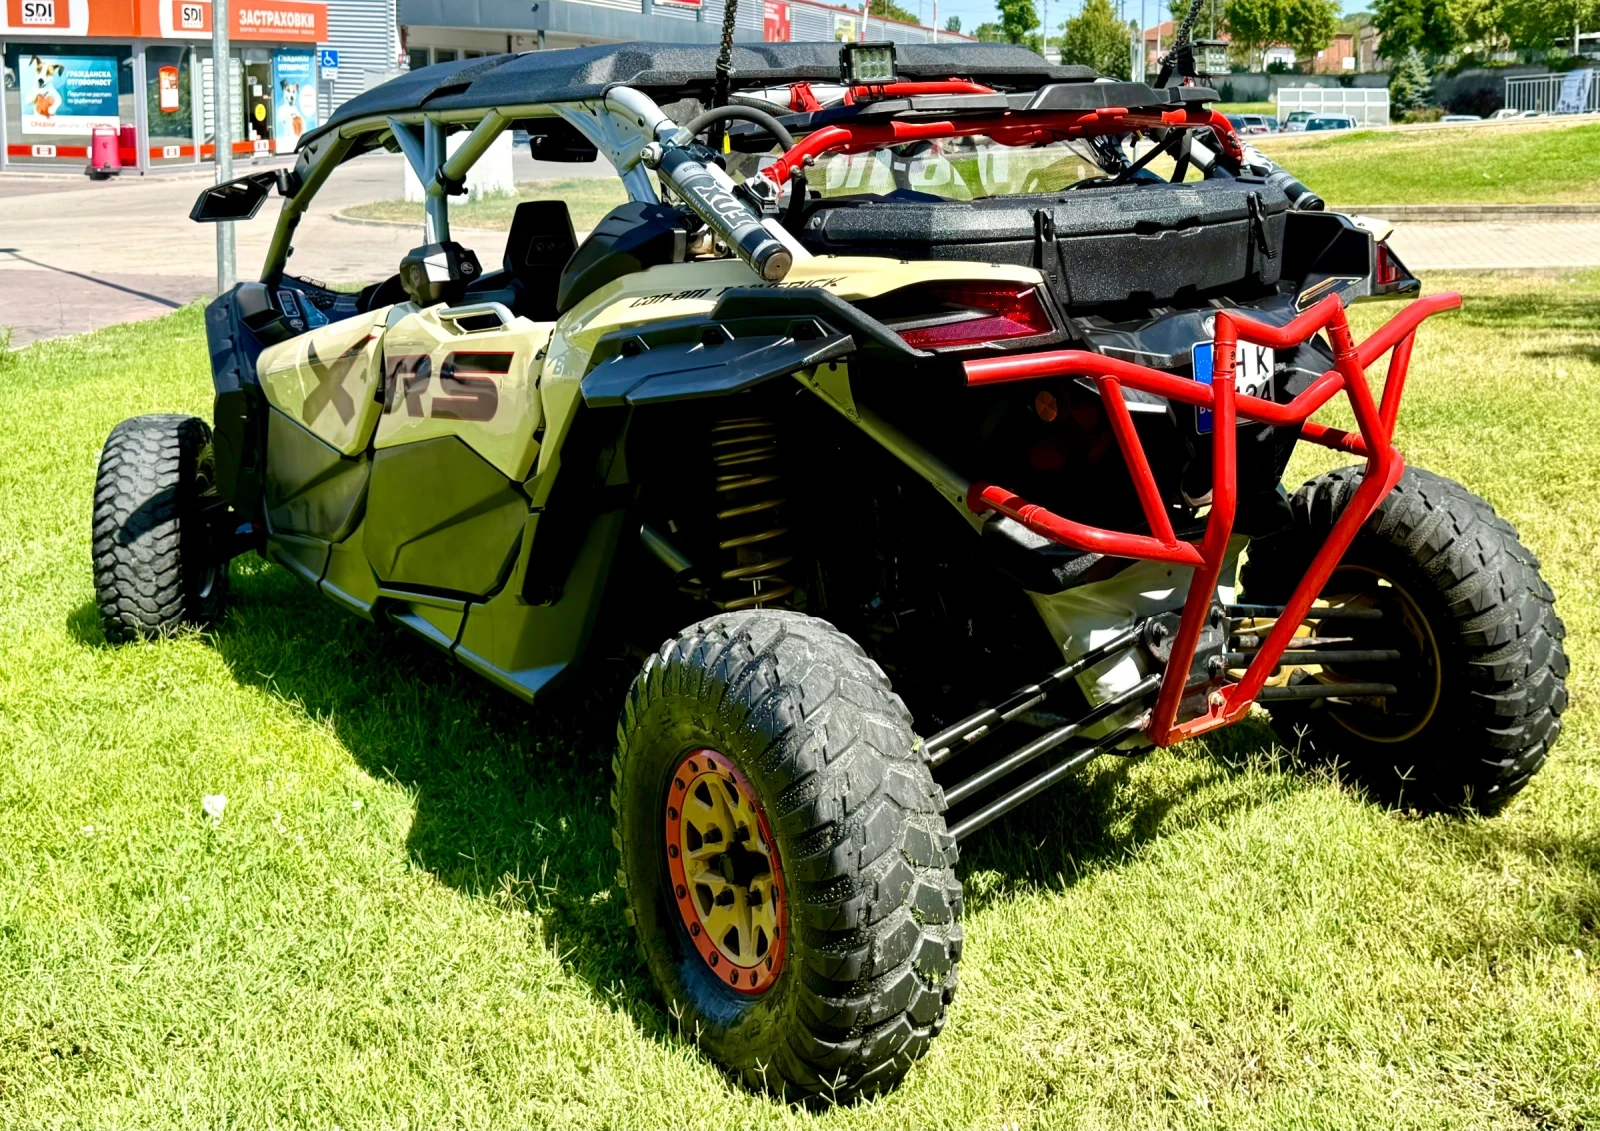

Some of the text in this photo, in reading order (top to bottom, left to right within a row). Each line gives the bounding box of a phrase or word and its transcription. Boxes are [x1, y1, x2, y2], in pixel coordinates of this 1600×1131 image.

[25, 3, 52, 18] SDI
[183, 7, 202, 22] SDI
[239, 9, 315, 28] ЗАСТРАХОВКИ
[66, 78, 112, 86] ОТГОВОРНОСТ
[692, 180, 759, 229] FOX
[628, 287, 712, 309] can-am
